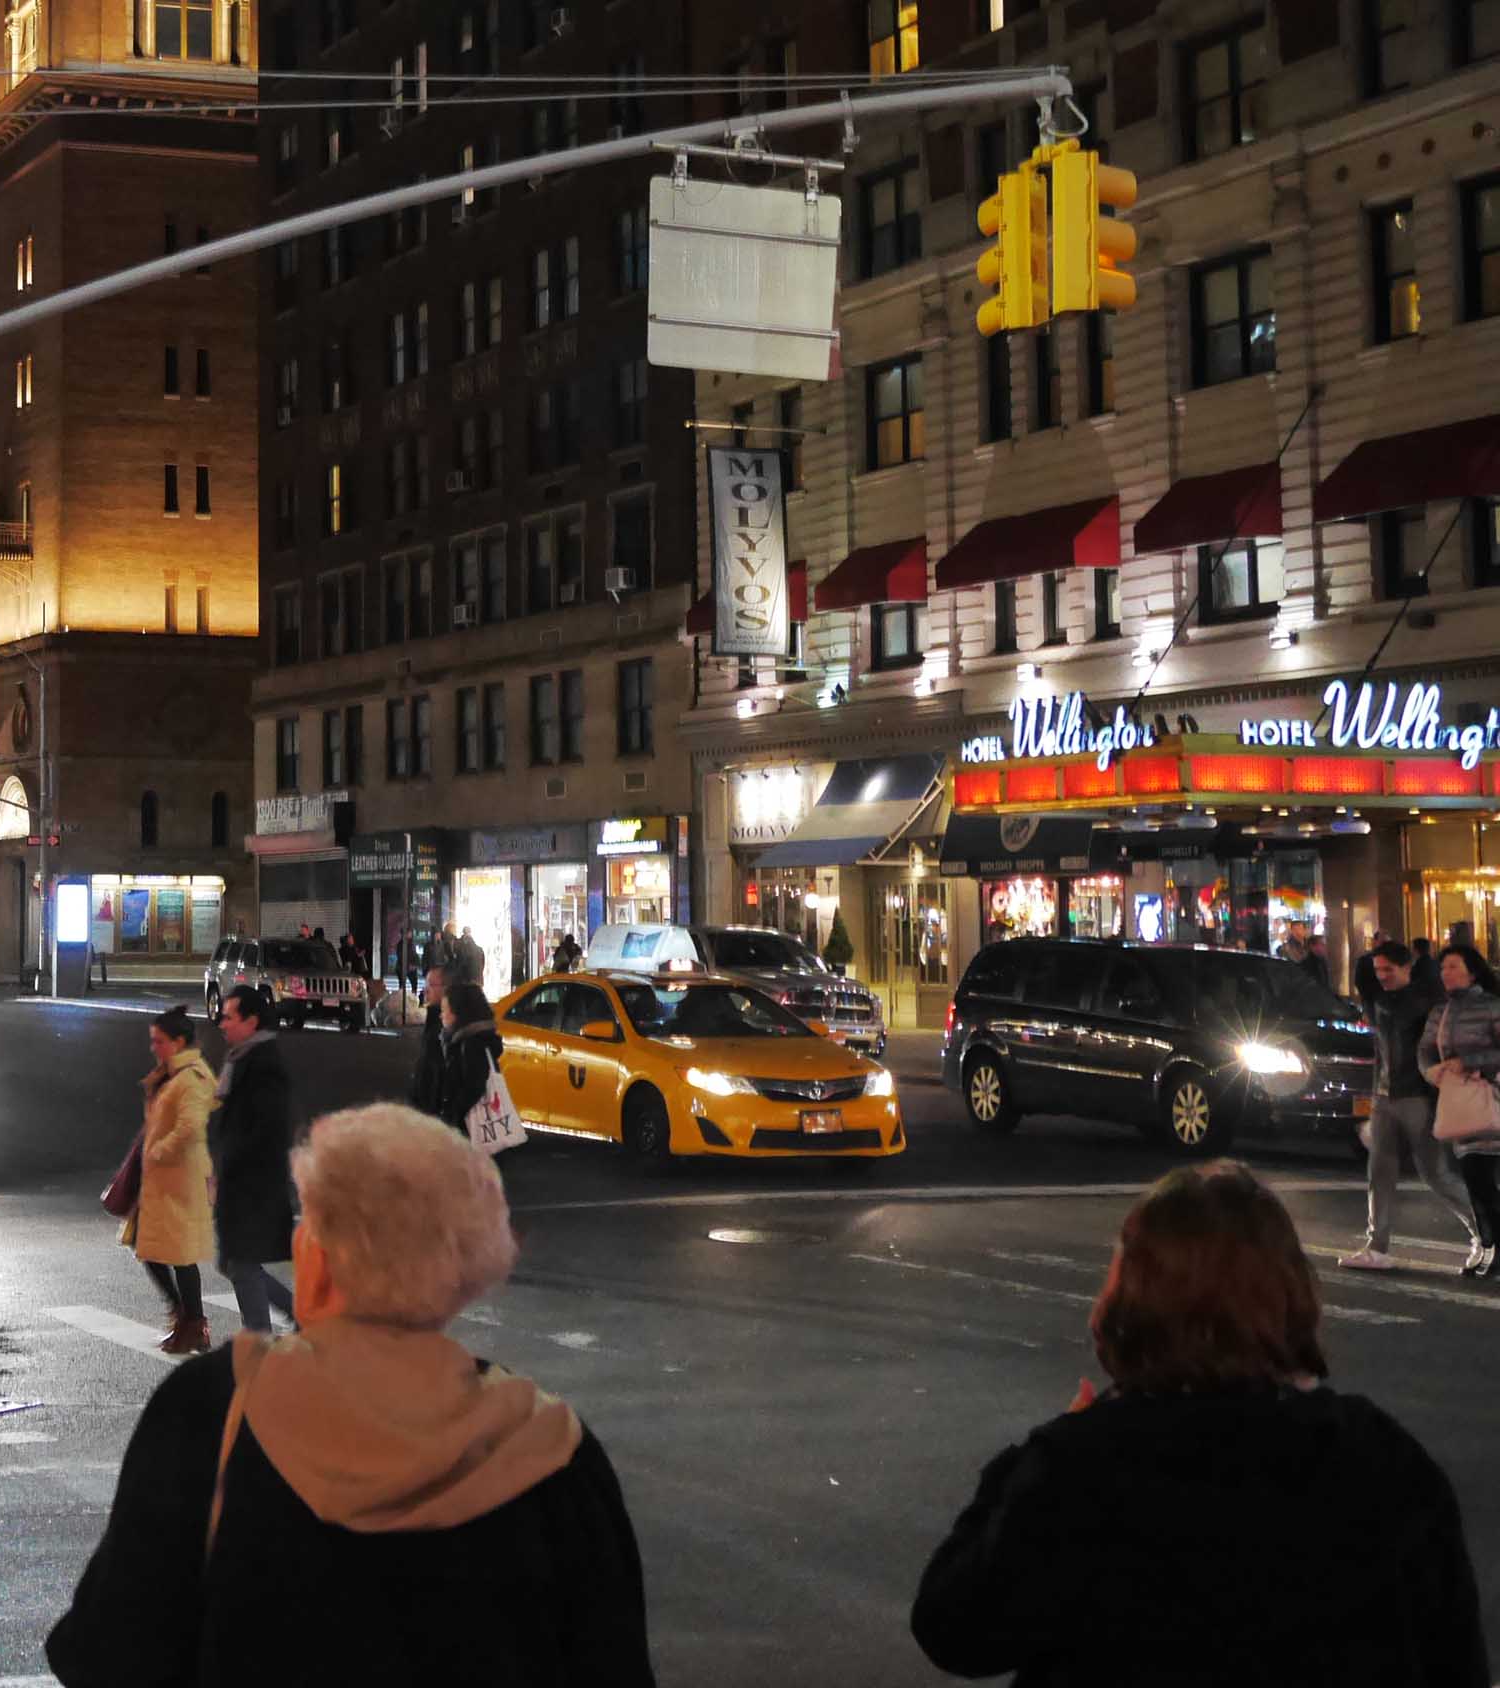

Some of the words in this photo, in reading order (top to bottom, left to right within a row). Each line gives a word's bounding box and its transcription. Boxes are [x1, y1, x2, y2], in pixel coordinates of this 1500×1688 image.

[728, 457, 771, 631] MOLYVOS
[961, 735, 1005, 763] HOTEL
[1008, 690, 1155, 772] Wellington
[1240, 719, 1316, 747] HOTEL
[1323, 679, 1500, 770] Wellingt
[732, 823, 796, 840] MOLYV
[384, 853, 414, 870] LUGGAE
[480, 1114, 511, 1144] NY
